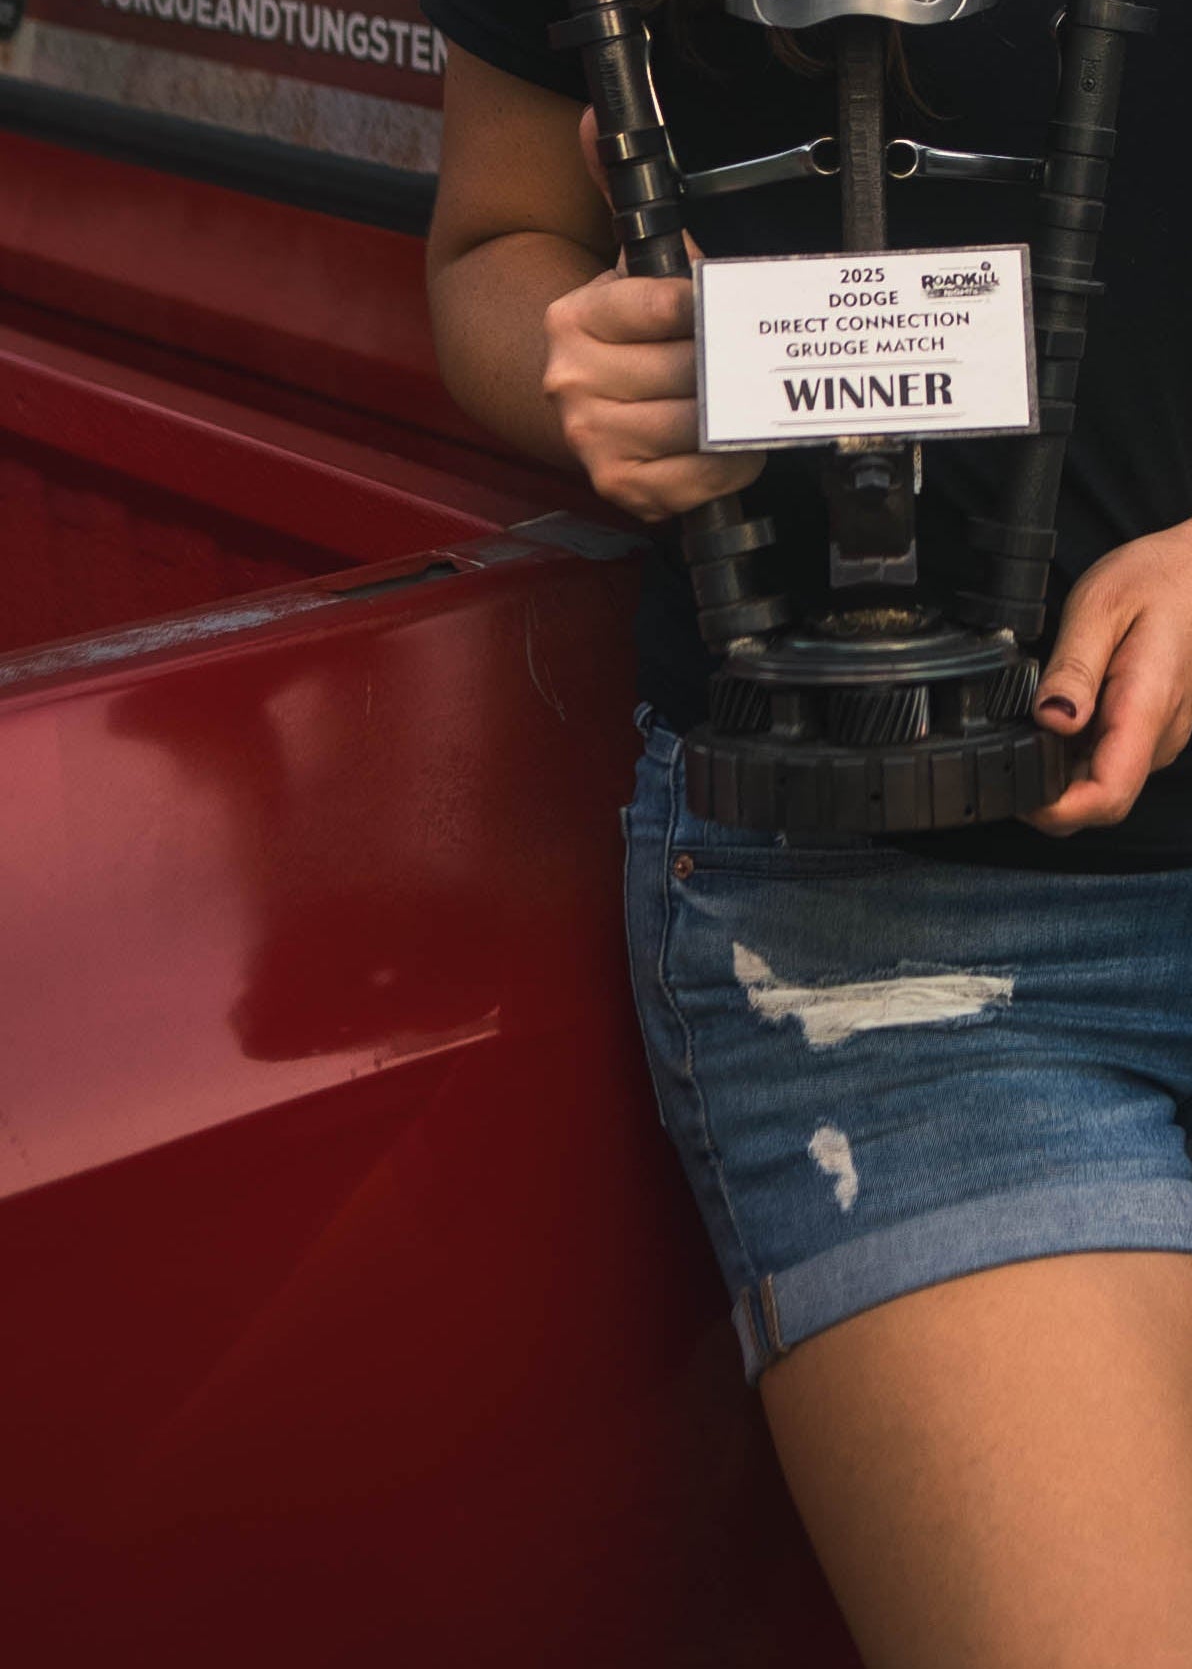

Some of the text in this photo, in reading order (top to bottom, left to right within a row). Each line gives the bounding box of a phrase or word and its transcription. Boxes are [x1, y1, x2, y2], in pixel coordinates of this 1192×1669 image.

[839, 267, 886, 284] 2025
[921, 271, 1000, 290] ROADKILL
[829, 291, 899, 308] DODGE
[759, 311, 970, 335] DIRECT CONNECTION
[786, 336, 945, 358] GRUDGE MATCH
[782, 372, 953, 412] WINNER
